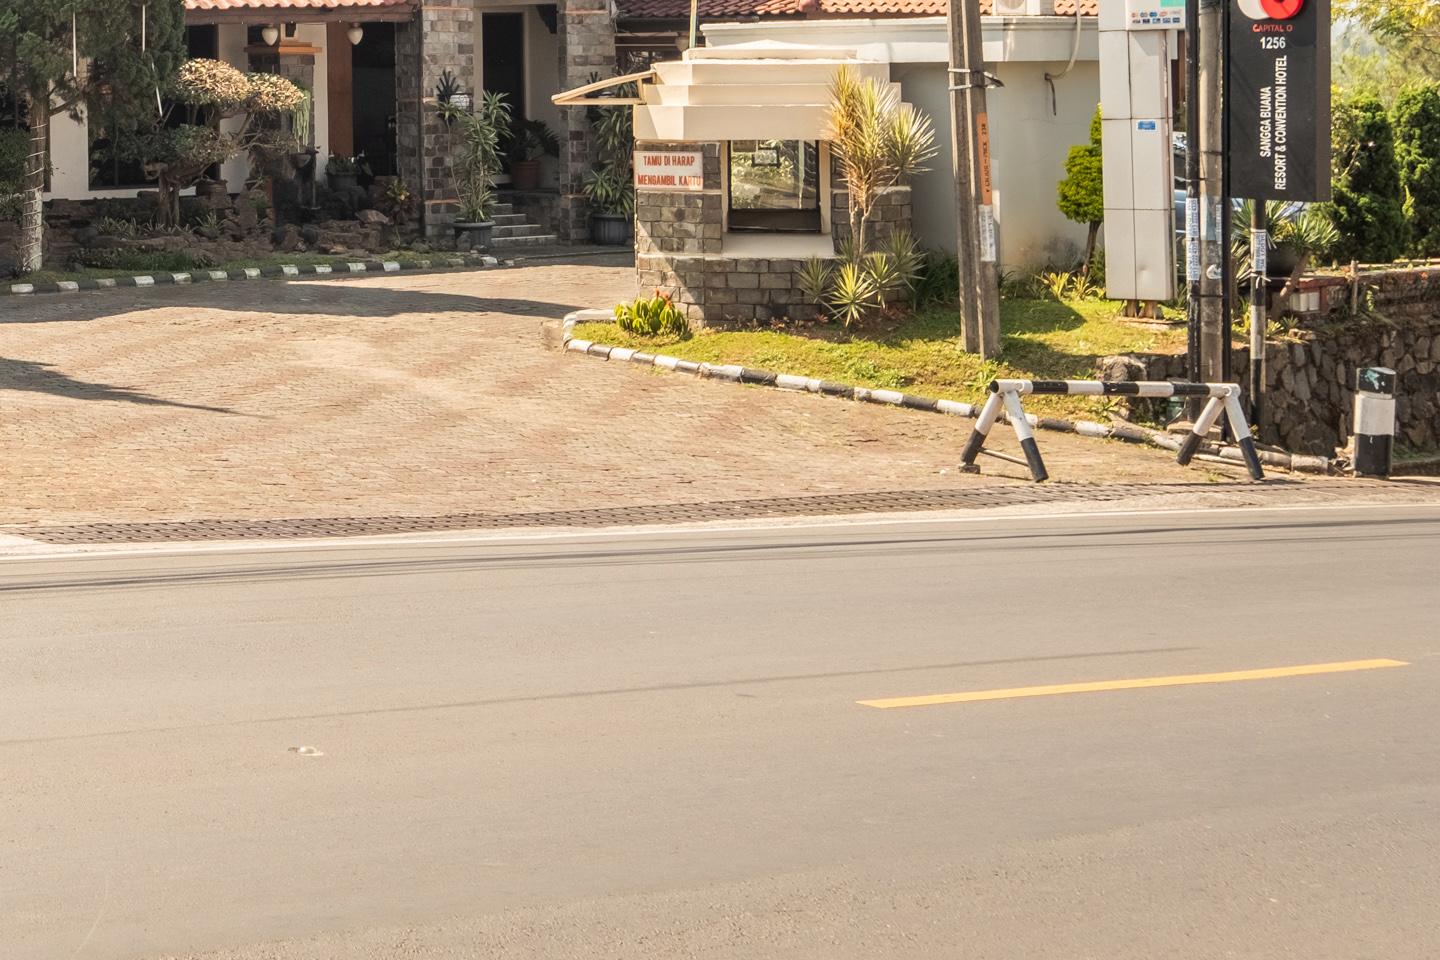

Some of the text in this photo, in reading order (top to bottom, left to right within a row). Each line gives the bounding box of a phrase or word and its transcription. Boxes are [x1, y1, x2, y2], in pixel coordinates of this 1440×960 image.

[1252, 23, 1293, 33] CAPITAL O
[1260, 36, 1286, 50] 1256
[1274, 54, 1287, 85] HOTEL
[1259, 86, 1272, 158] SANGGA BUANA
[1274, 86, 1287, 144] CONVENTION
[643, 155, 695, 166] TAMU DI HARAP
[1274, 152, 1287, 190] RESORT
[637, 174, 701, 186] MENGAMBIL KARTU
